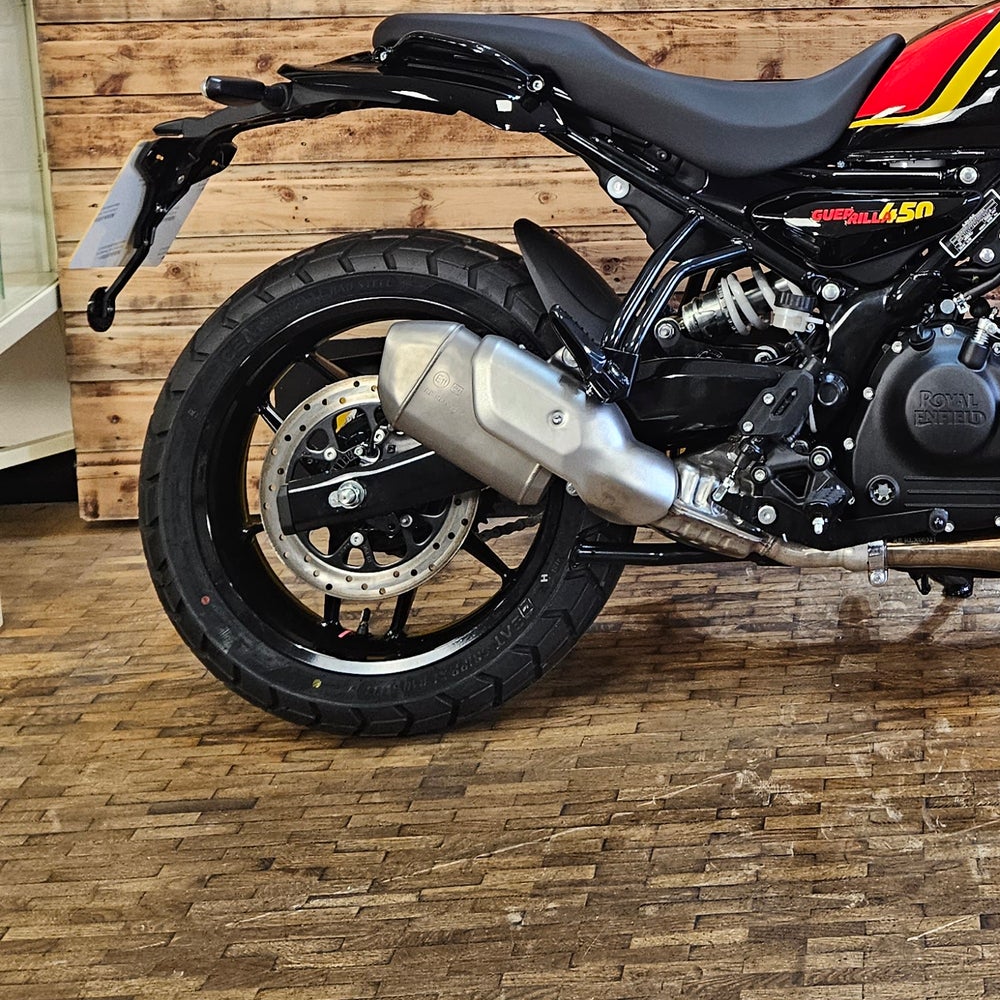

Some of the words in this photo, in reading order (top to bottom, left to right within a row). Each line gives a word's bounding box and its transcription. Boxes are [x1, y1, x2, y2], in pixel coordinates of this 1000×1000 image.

[811, 207, 894, 226] GUERRILLA
[879, 201, 935, 224] 450
[919, 389, 979, 410] ROYAL
[913, 409, 987, 428] ENFIELD
